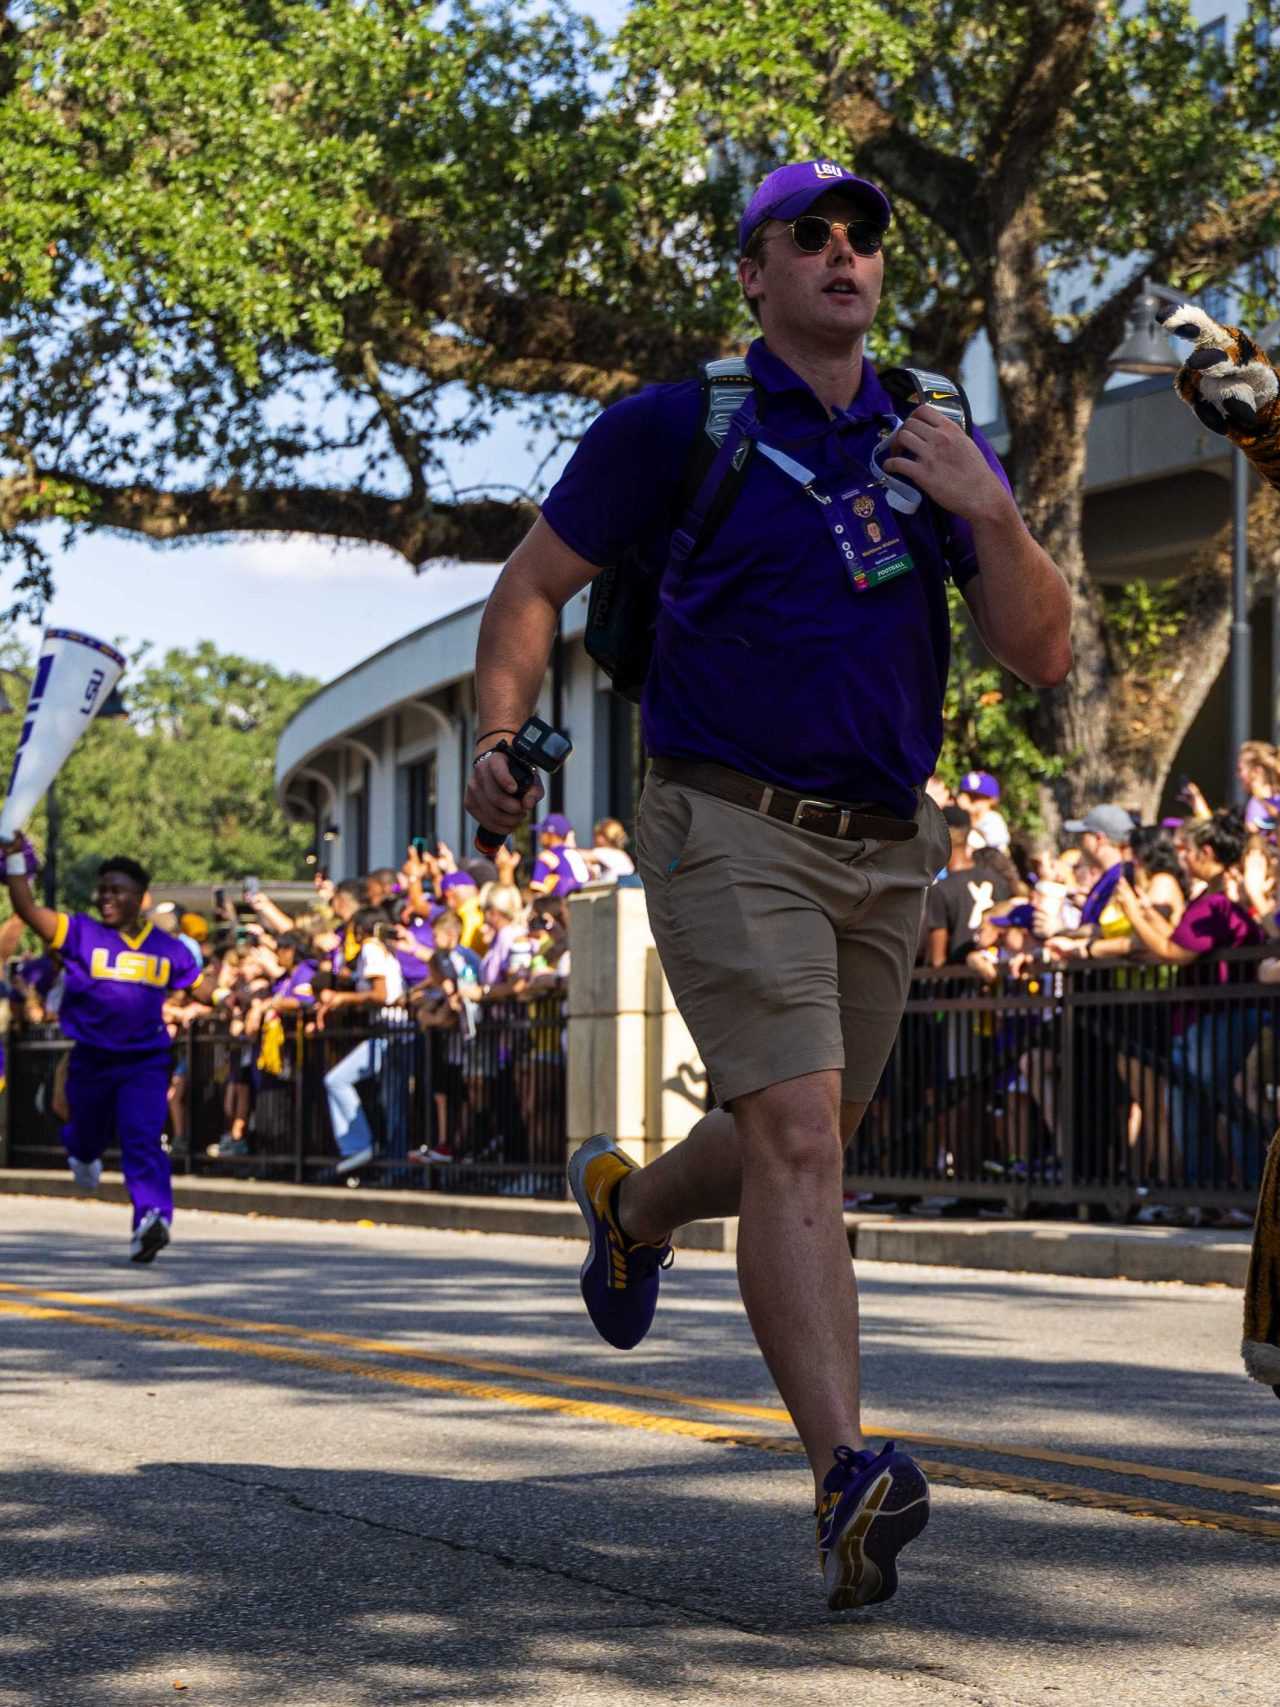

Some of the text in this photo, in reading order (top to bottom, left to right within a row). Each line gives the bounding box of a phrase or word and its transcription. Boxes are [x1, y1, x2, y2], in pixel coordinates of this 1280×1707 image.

[813, 162, 843, 178] LSU
[80, 668, 105, 715] LSU
[90, 947, 171, 987] LSU
